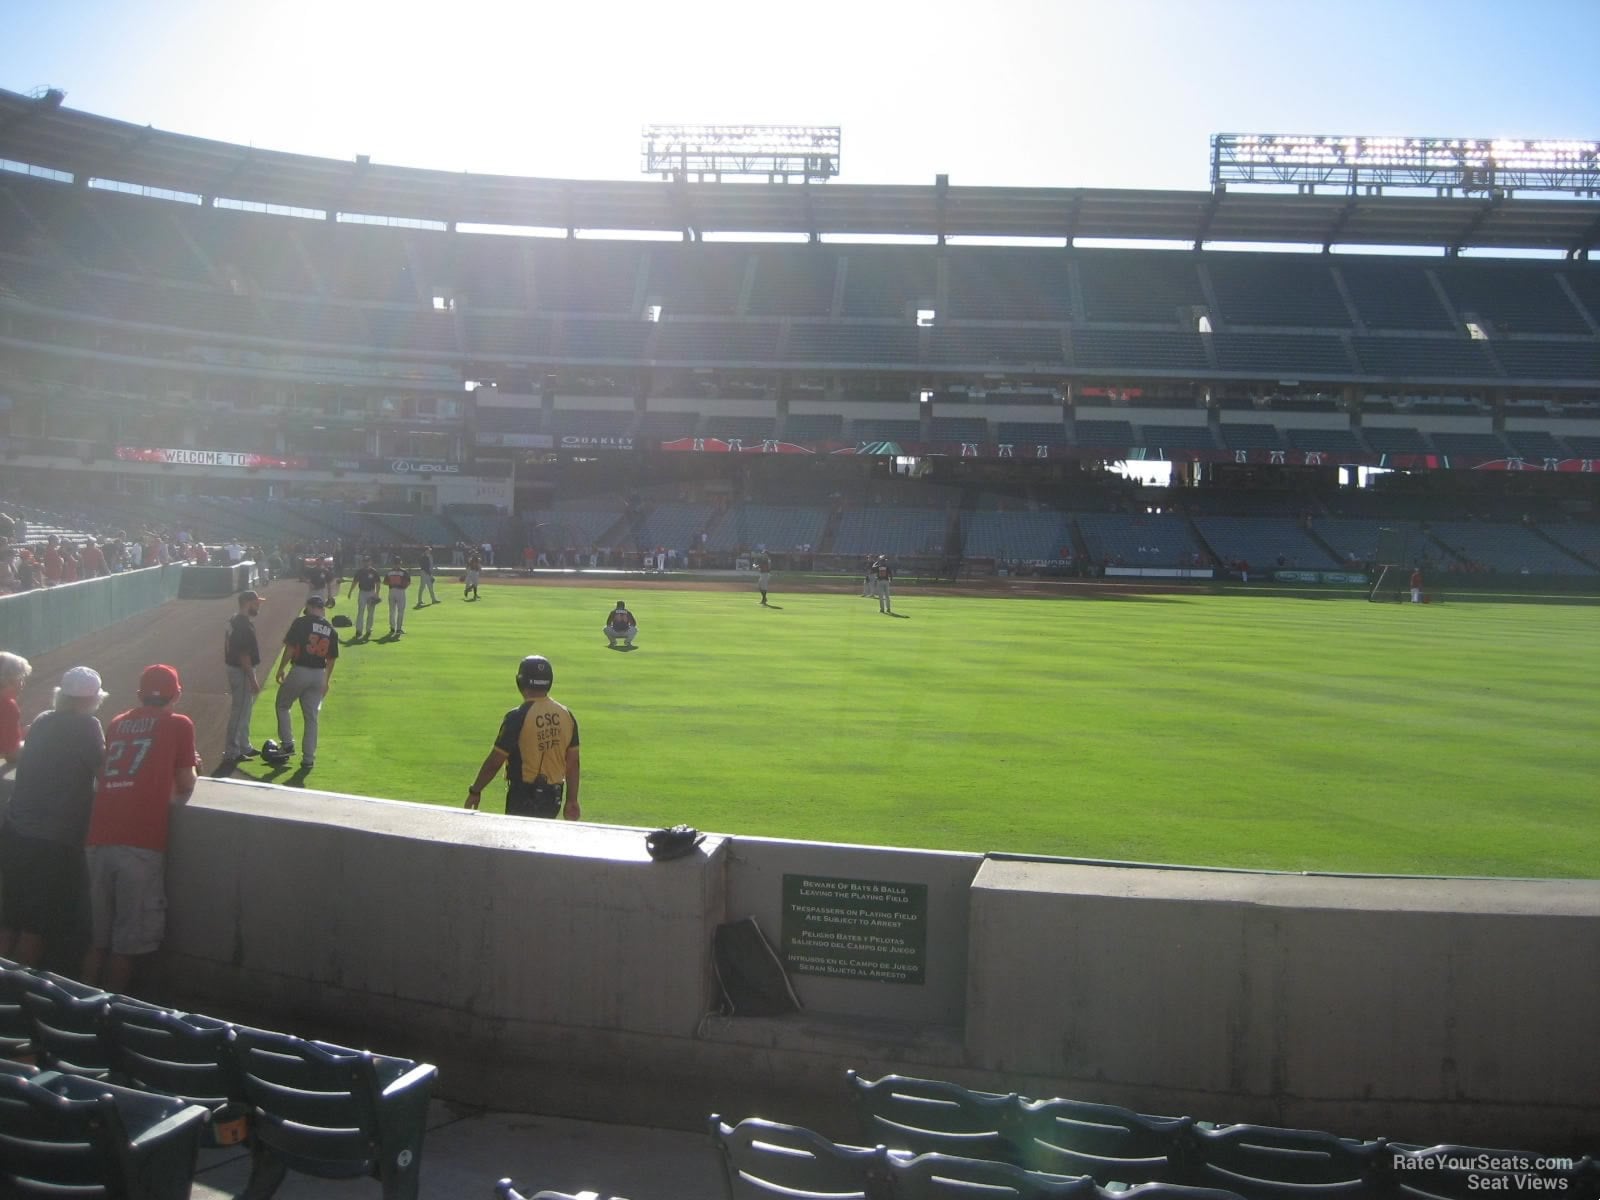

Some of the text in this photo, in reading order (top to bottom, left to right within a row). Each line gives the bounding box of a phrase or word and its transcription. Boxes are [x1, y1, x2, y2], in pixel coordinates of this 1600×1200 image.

[165, 450, 247, 466] WELCOME TO
[411, 463, 459, 473] LEXUS
[536, 713, 560, 728] CSC
[105, 739, 152, 776] 27
[803, 880, 835, 889] BEWARE
[881, 886, 906, 894] BALLS
[800, 889, 832, 897] LEAVING
[851, 893, 883, 901] PLAYING
[886, 895, 909, 903] FIELD
[792, 904, 844, 915] TRESPASSERS
[860, 910, 892, 919] PLAYING
[894, 912, 917, 920] FIELD
[824, 916, 857, 924] SUBJECT
[872, 919, 901, 927] ARREST
[792, 938, 829, 947] SALIENDO
[847, 943, 875, 951] CAMPO
[890, 946, 915, 954] JUEGO
[837, 933, 862, 941] BATES
[870, 936, 904, 945] PELOTAS
[788, 955, 824, 964] INTRUSOS
[850, 960, 877, 968] CAMPO
[892, 963, 918, 971] JUEGO
[799, 964, 825, 972] SERAN
[870, 970, 906, 979] ARRESTO
